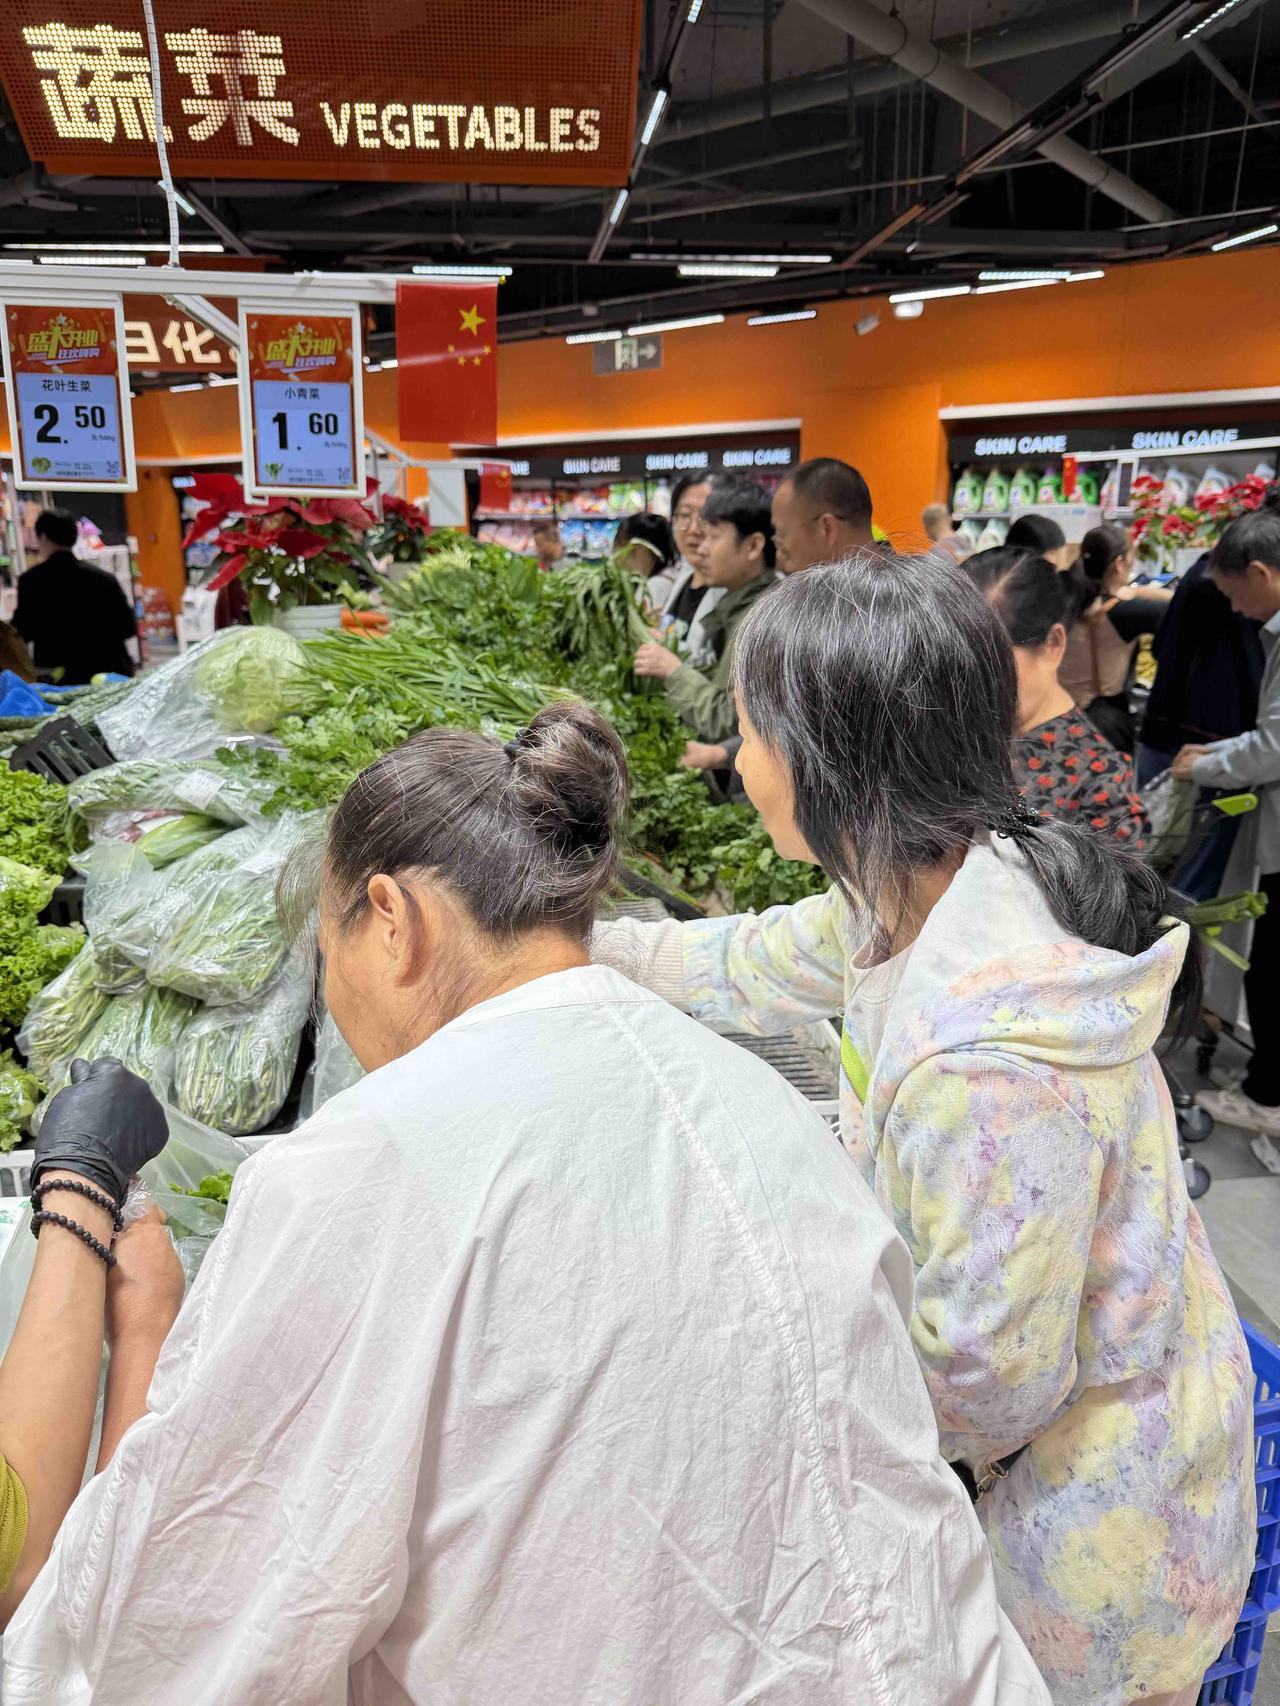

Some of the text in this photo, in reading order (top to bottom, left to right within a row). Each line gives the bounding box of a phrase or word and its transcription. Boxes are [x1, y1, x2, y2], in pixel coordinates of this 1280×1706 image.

[22, 22, 301, 146] 蔬菜
[319, 101, 600, 153] VEGETABLES
[42, 379, 91, 392] 花叶生菜
[284, 387, 320, 400] 小青菜
[74, 405, 106, 429] 50
[308, 412, 338, 435] 60
[975, 434, 1068, 456] SKIN CARE
[1131, 430, 1180, 449] SKIN
[675, 451, 709, 469] CARE
